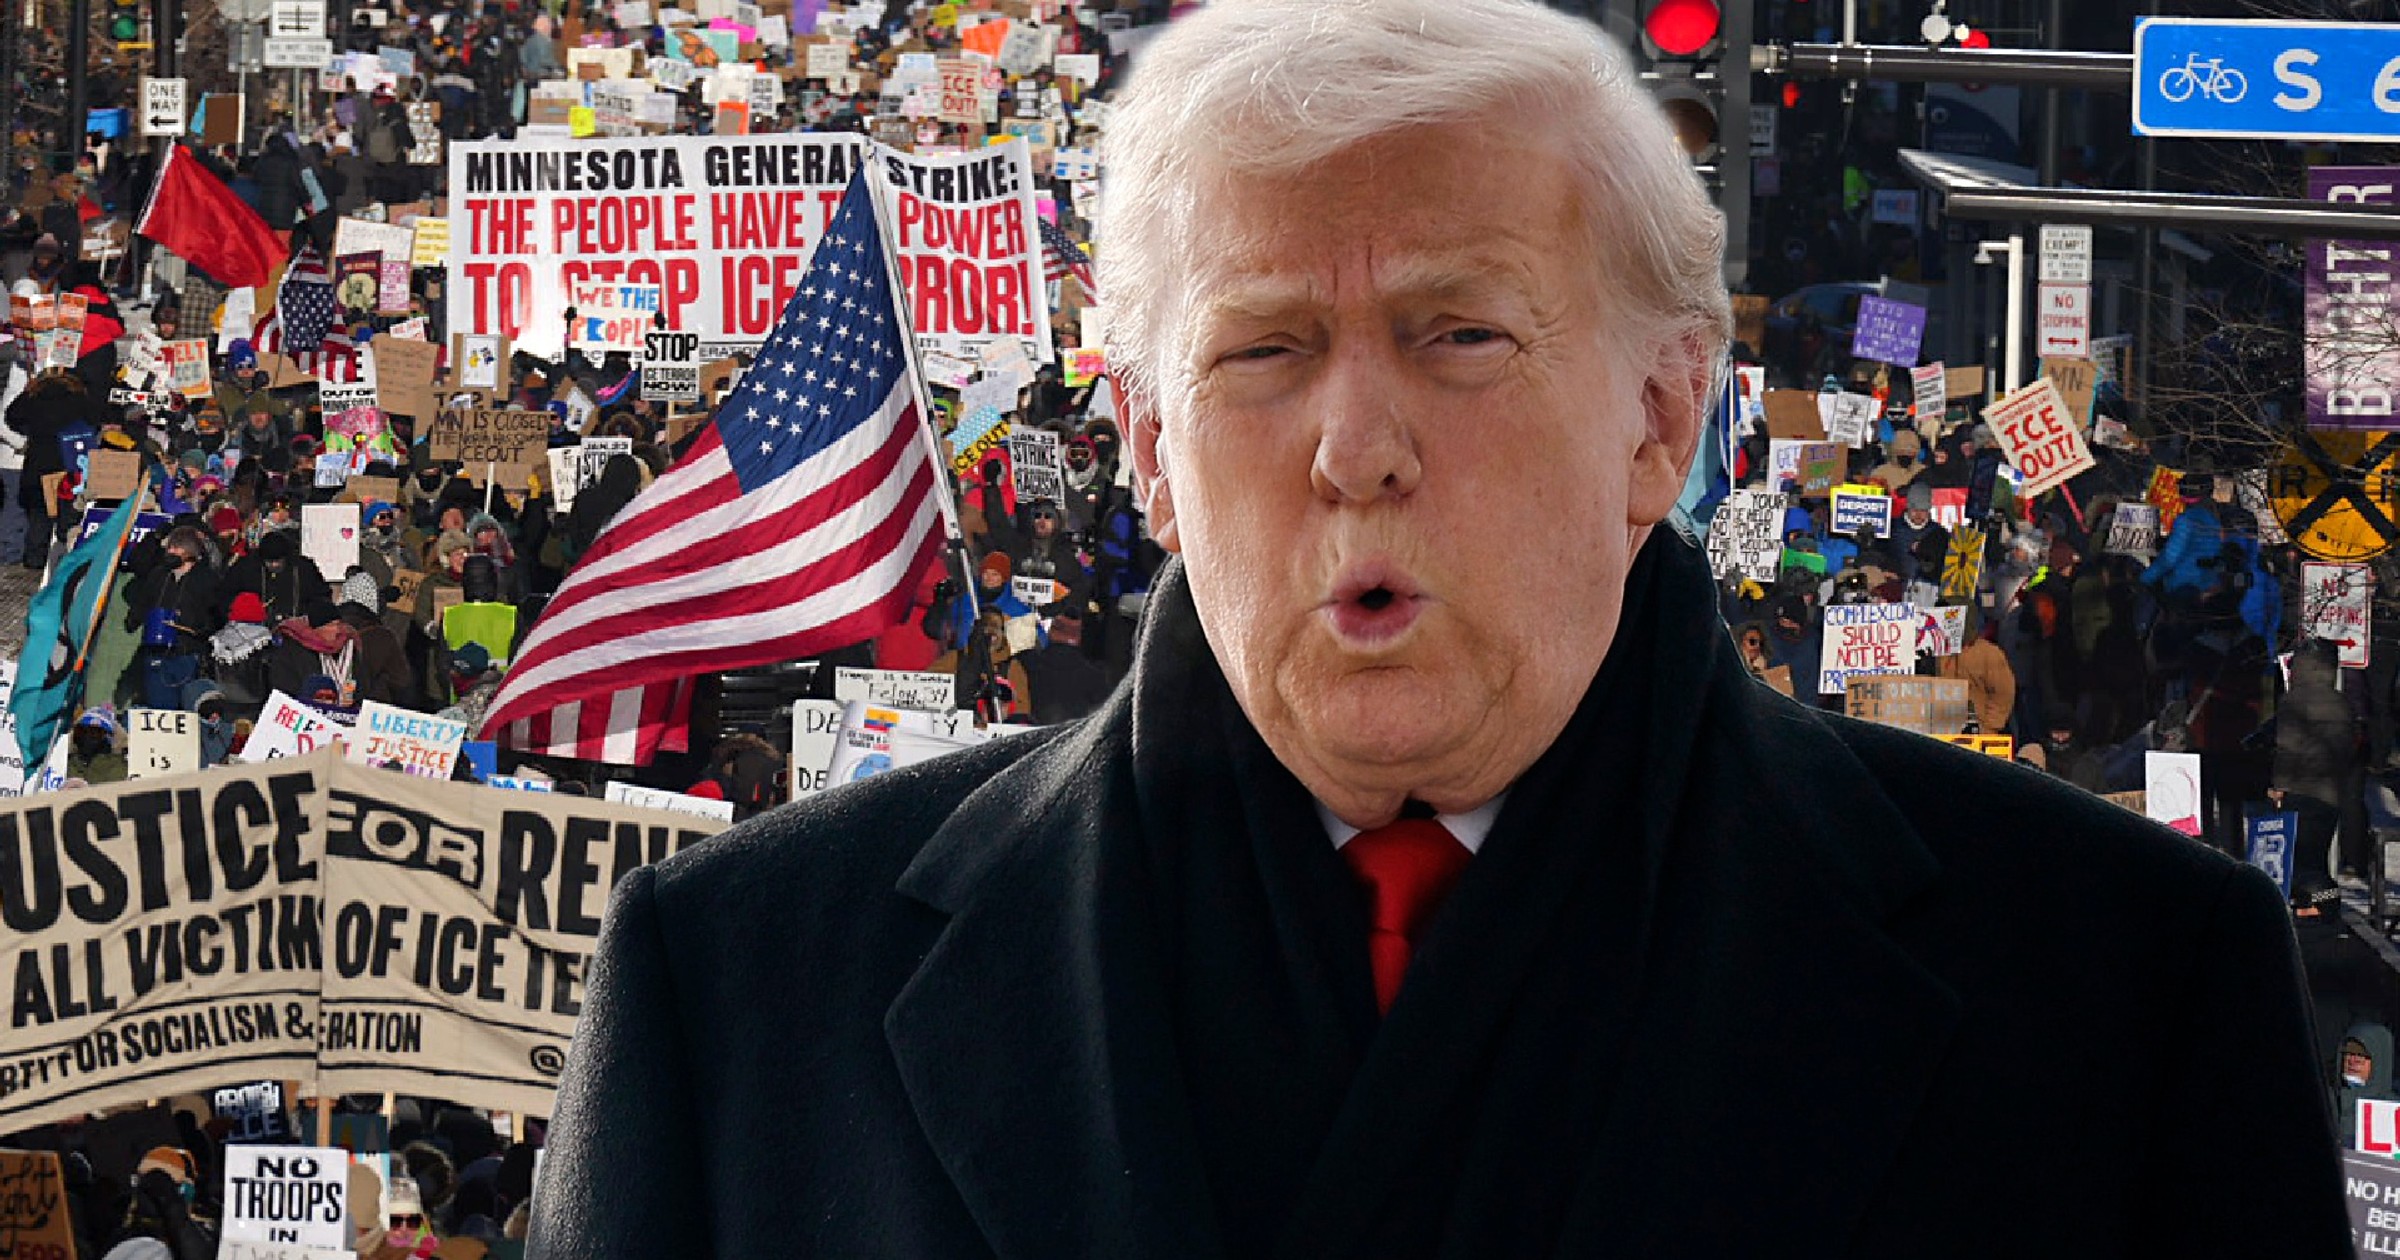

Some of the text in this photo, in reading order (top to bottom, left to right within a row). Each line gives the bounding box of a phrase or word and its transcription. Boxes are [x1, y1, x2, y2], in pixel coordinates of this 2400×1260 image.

[150, 85, 180, 98] ONE
[943, 74, 975, 97] ICE
[2273, 48, 2322, 112] S
[150, 99, 180, 112] WAY
[466, 149, 684, 194] MINNESOTA
[885, 154, 1019, 204] STRIKE:
[464, 198, 537, 255] THE
[552, 193, 698, 254] PEOPLE
[711, 190, 804, 251] HAVE
[899, 192, 1028, 260] POWER
[464, 261, 533, 342] TO
[722, 254, 801, 336] ICE
[576, 286, 661, 311] WE THE
[2055, 294, 2074, 308] NO
[2326, 185, 2393, 416] BRIGHTR
[2043, 314, 2084, 328] STOPPING
[644, 333, 699, 362] STOP
[322, 387, 376, 398] OUT OF
[2004, 404, 2064, 453] ICE
[2018, 430, 2078, 479] OUT!
[2280, 464, 2307, 499] R
[1842, 623, 1901, 646] SHOULD
[1837, 644, 1900, 668] NOT BE
[140, 712, 187, 735] ICE
[371, 711, 465, 744] LIBERTY
[150, 747, 172, 769] is
[366, 736, 451, 769] JUSTICE
[0, 770, 713, 936] USTICE FOR REN
[12, 938, 118, 1029] ALL
[124, 894, 325, 998] VICTIM
[336, 901, 408, 979] OF
[414, 912, 514, 1002] ICE
[121, 1002, 280, 1064] SOCIALISM
[285, 1002, 315, 1040] &
[257, 1157, 320, 1179] NO
[230, 1177, 343, 1223] TROOPS
[2346, 1177, 2379, 1201] NO
[269, 1227, 299, 1243] IN
